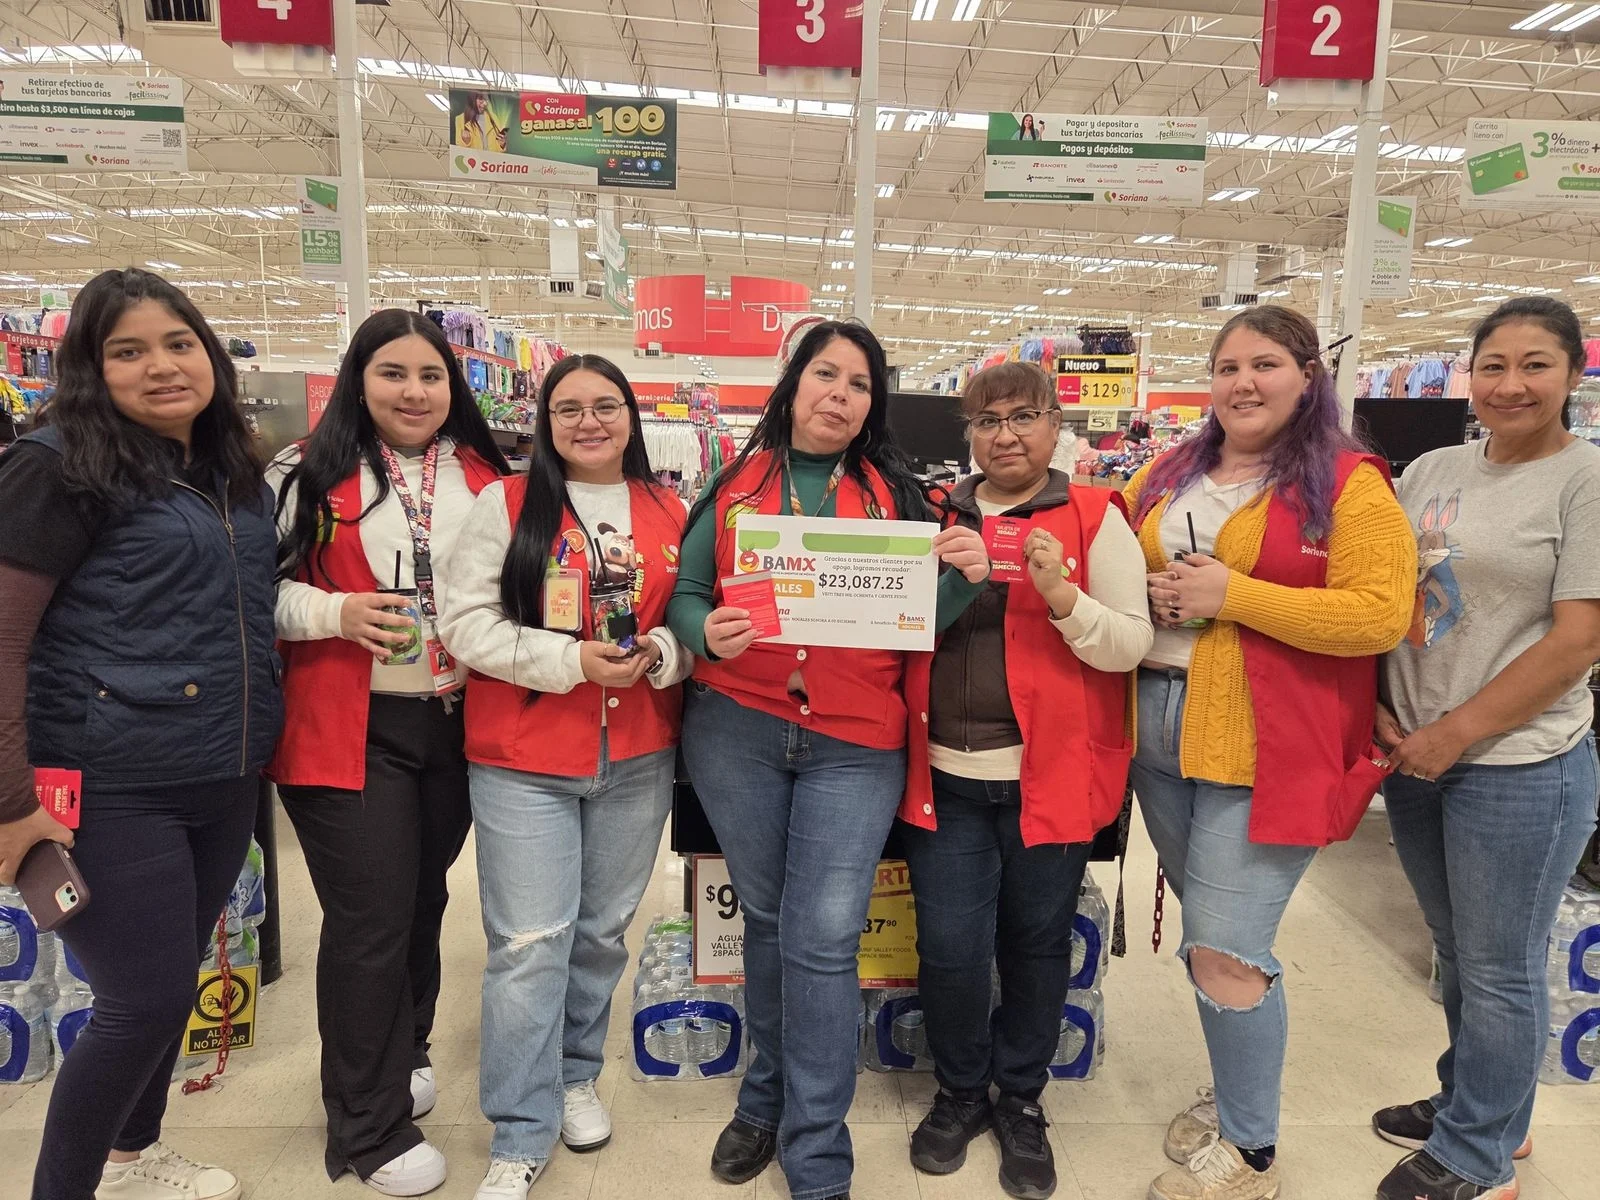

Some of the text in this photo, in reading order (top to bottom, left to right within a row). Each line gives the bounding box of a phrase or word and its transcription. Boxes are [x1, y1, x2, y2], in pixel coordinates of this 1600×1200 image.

[796, 0, 825, 43] 3
[1310, 5, 1341, 56] 2
[28, 78, 105, 89] Retirar efectivo de
[21, 87, 112, 98] tus tarjetas bancarias
[16, 104, 39, 113] hasta
[40, 105, 68, 115] $3,500
[69, 106, 80, 114] en
[80, 106, 101, 115] línea
[102, 106, 113, 116] de
[113, 108, 136, 118] cajas
[543, 105, 580, 115] Soriana
[520, 105, 666, 134] ganas al 100
[1066, 119, 1088, 129] Pagar
[1090, 120, 1095, 129] y
[1097, 120, 1132, 129] depositar
[1474, 122, 1499, 130] Carrito
[1061, 129, 1143, 139] tus tarjetas bancarias
[20, 140, 39, 148] invex
[1567, 138, 1590, 146] dinero
[612, 149, 641, 158] recarga
[642, 150, 667, 159] gratis.
[1060, 144, 1134, 155] Pagos y depósitos
[1549, 146, 1589, 154] electrónico
[100, 157, 130, 165] Soriana
[480, 161, 529, 175] Soriana
[1118, 194, 1149, 202] Soriana
[327, 240, 339, 248] de
[304, 247, 340, 255] cashback
[1373, 258, 1389, 267] 3%
[1372, 265, 1402, 273] Cashback
[763, 303, 782, 332] D
[6, 333, 38, 346] Tarjetas
[40, 338, 49, 346] de
[1064, 360, 1099, 371] Nuevo
[310, 401, 320, 412] LA
[422, 465, 435, 490] Hello
[763, 555, 817, 572] BAMX
[823, 555, 847, 563] Gracias
[852, 556, 881, 564] nuestros
[881, 557, 903, 565] clientes
[832, 564, 853, 573] apoyo,
[853, 563, 881, 573] logramos
[818, 572, 904, 591] $23,087.25
[54, 787, 62, 812] REGALO
[873, 865, 911, 887] RT
[886, 919, 897, 927] 90
[717, 934, 744, 942] AGUA
[206, 1027, 234, 1040] ALO
[193, 1039, 209, 1050] NO
